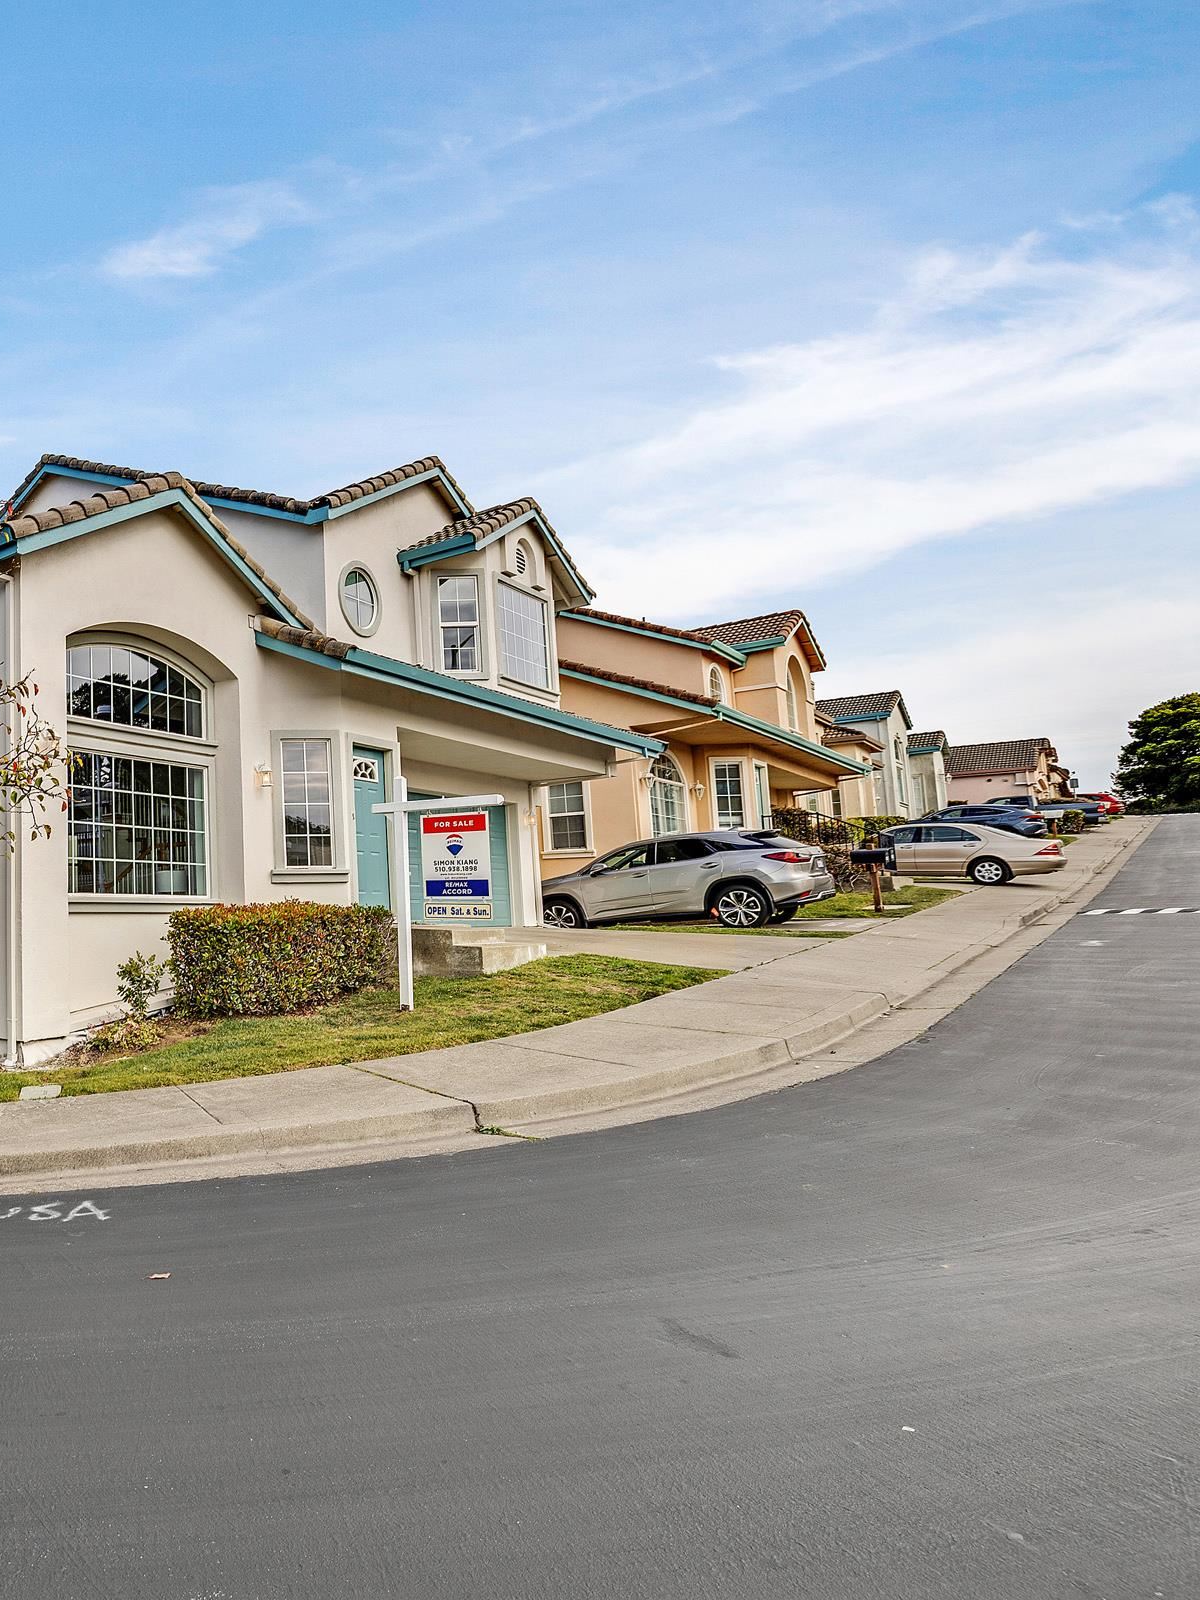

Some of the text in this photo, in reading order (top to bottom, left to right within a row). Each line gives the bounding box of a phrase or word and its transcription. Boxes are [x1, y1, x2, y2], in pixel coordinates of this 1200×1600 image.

[452, 819, 474, 827] SALE
[427, 906, 447, 915] OPEN
[450, 906, 464, 915] Sat.
[473, 906, 489, 916] Sun.
